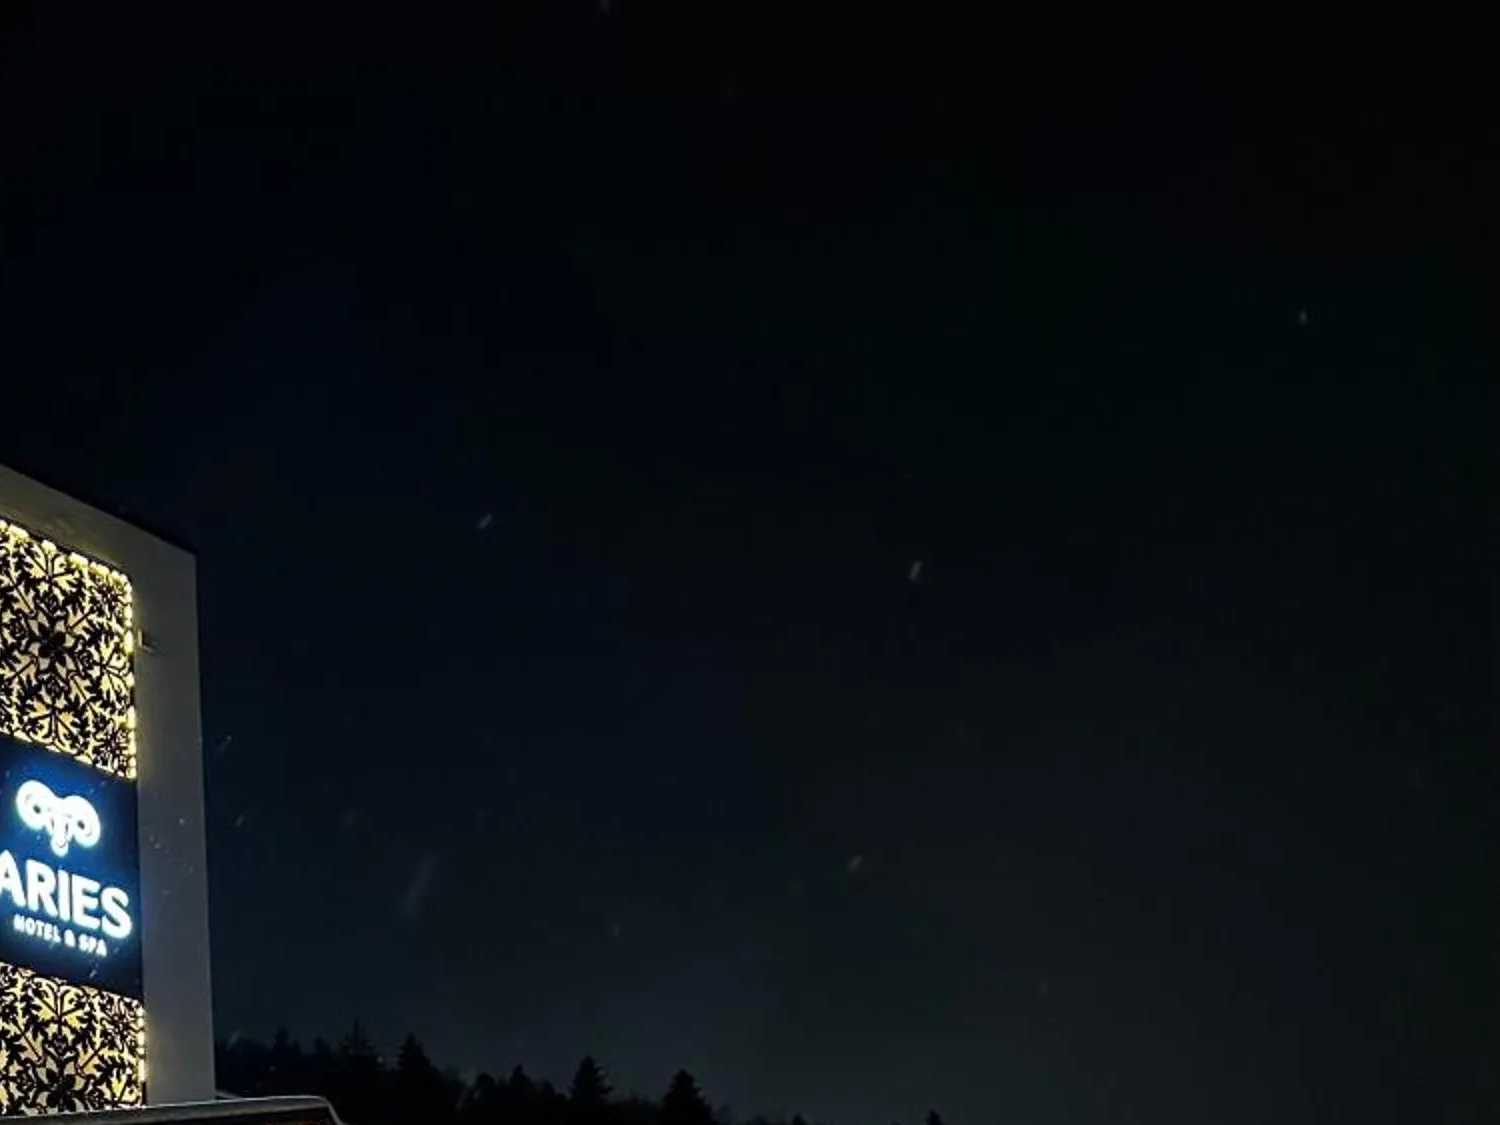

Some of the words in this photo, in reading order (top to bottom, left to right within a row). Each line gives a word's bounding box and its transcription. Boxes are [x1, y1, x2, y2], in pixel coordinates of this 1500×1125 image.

[13, 914, 62, 943] HOTEL
[63, 929, 77, 948] &
[78, 934, 107, 957] SPA
